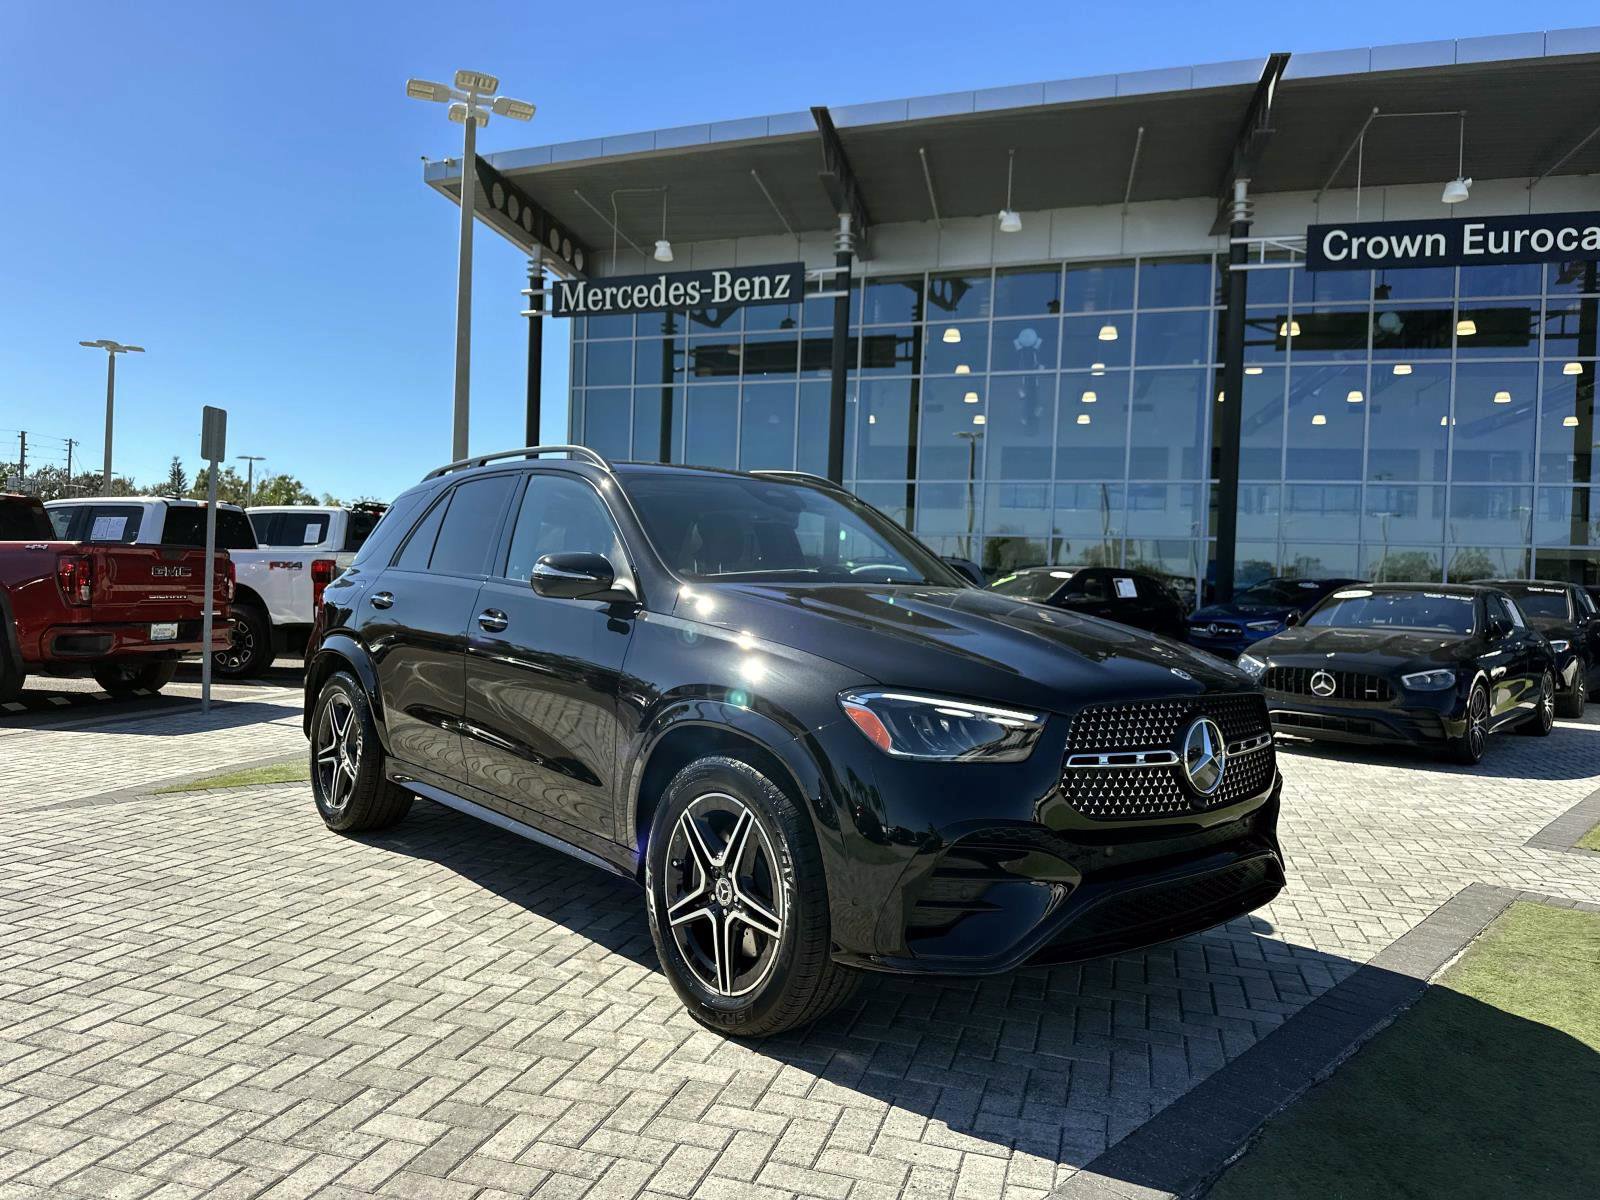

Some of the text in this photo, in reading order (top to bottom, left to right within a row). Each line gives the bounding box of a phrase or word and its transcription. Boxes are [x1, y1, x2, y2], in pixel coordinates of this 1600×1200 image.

[1322, 223, 1600, 261] Crown Euroca
[559, 271, 791, 312] Mercedes-Benz
[151, 566, 192, 577] GMC
[269, 561, 303, 570] FX4
